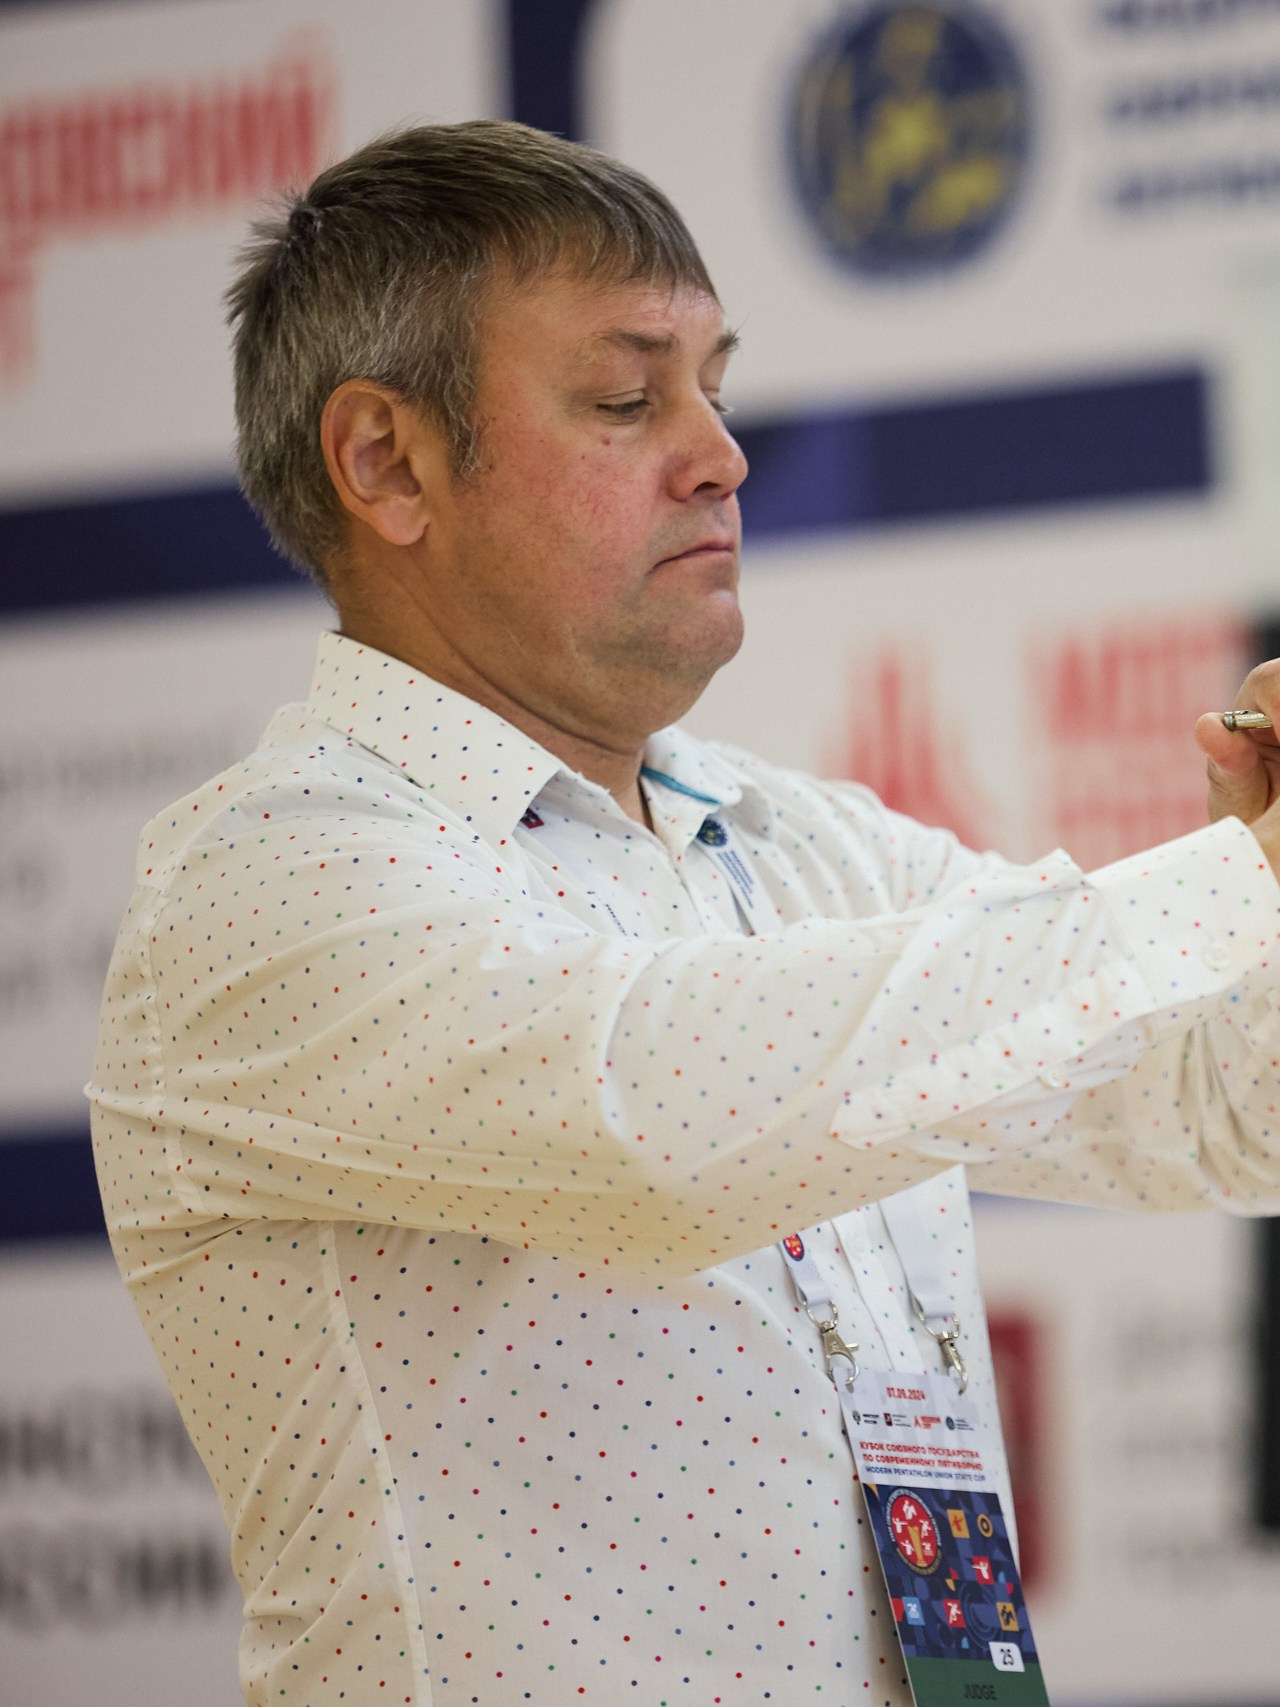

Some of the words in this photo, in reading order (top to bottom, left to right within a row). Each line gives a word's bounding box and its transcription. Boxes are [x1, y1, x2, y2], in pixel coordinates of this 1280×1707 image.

[859, 1441, 884, 1451] КУБОК
[886, 1443, 926, 1455] СОЮЗНОГО
[927, 1446, 980, 1459] ГОСУДАРСТВА
[862, 1453, 874, 1462] ПО
[875, 1454, 935, 1467] СОВРЕМЕННОМУ
[937, 1459, 984, 1472] ПЯТИБОРЬЮ
[865, 1466, 893, 1475] MODERN
[893, 1468, 933, 1478] PENTATHLON
[933, 1471, 953, 1479] UNION
[1000, 1648, 1015, 1666] 25
[963, 1682, 998, 1701] JUDGE
